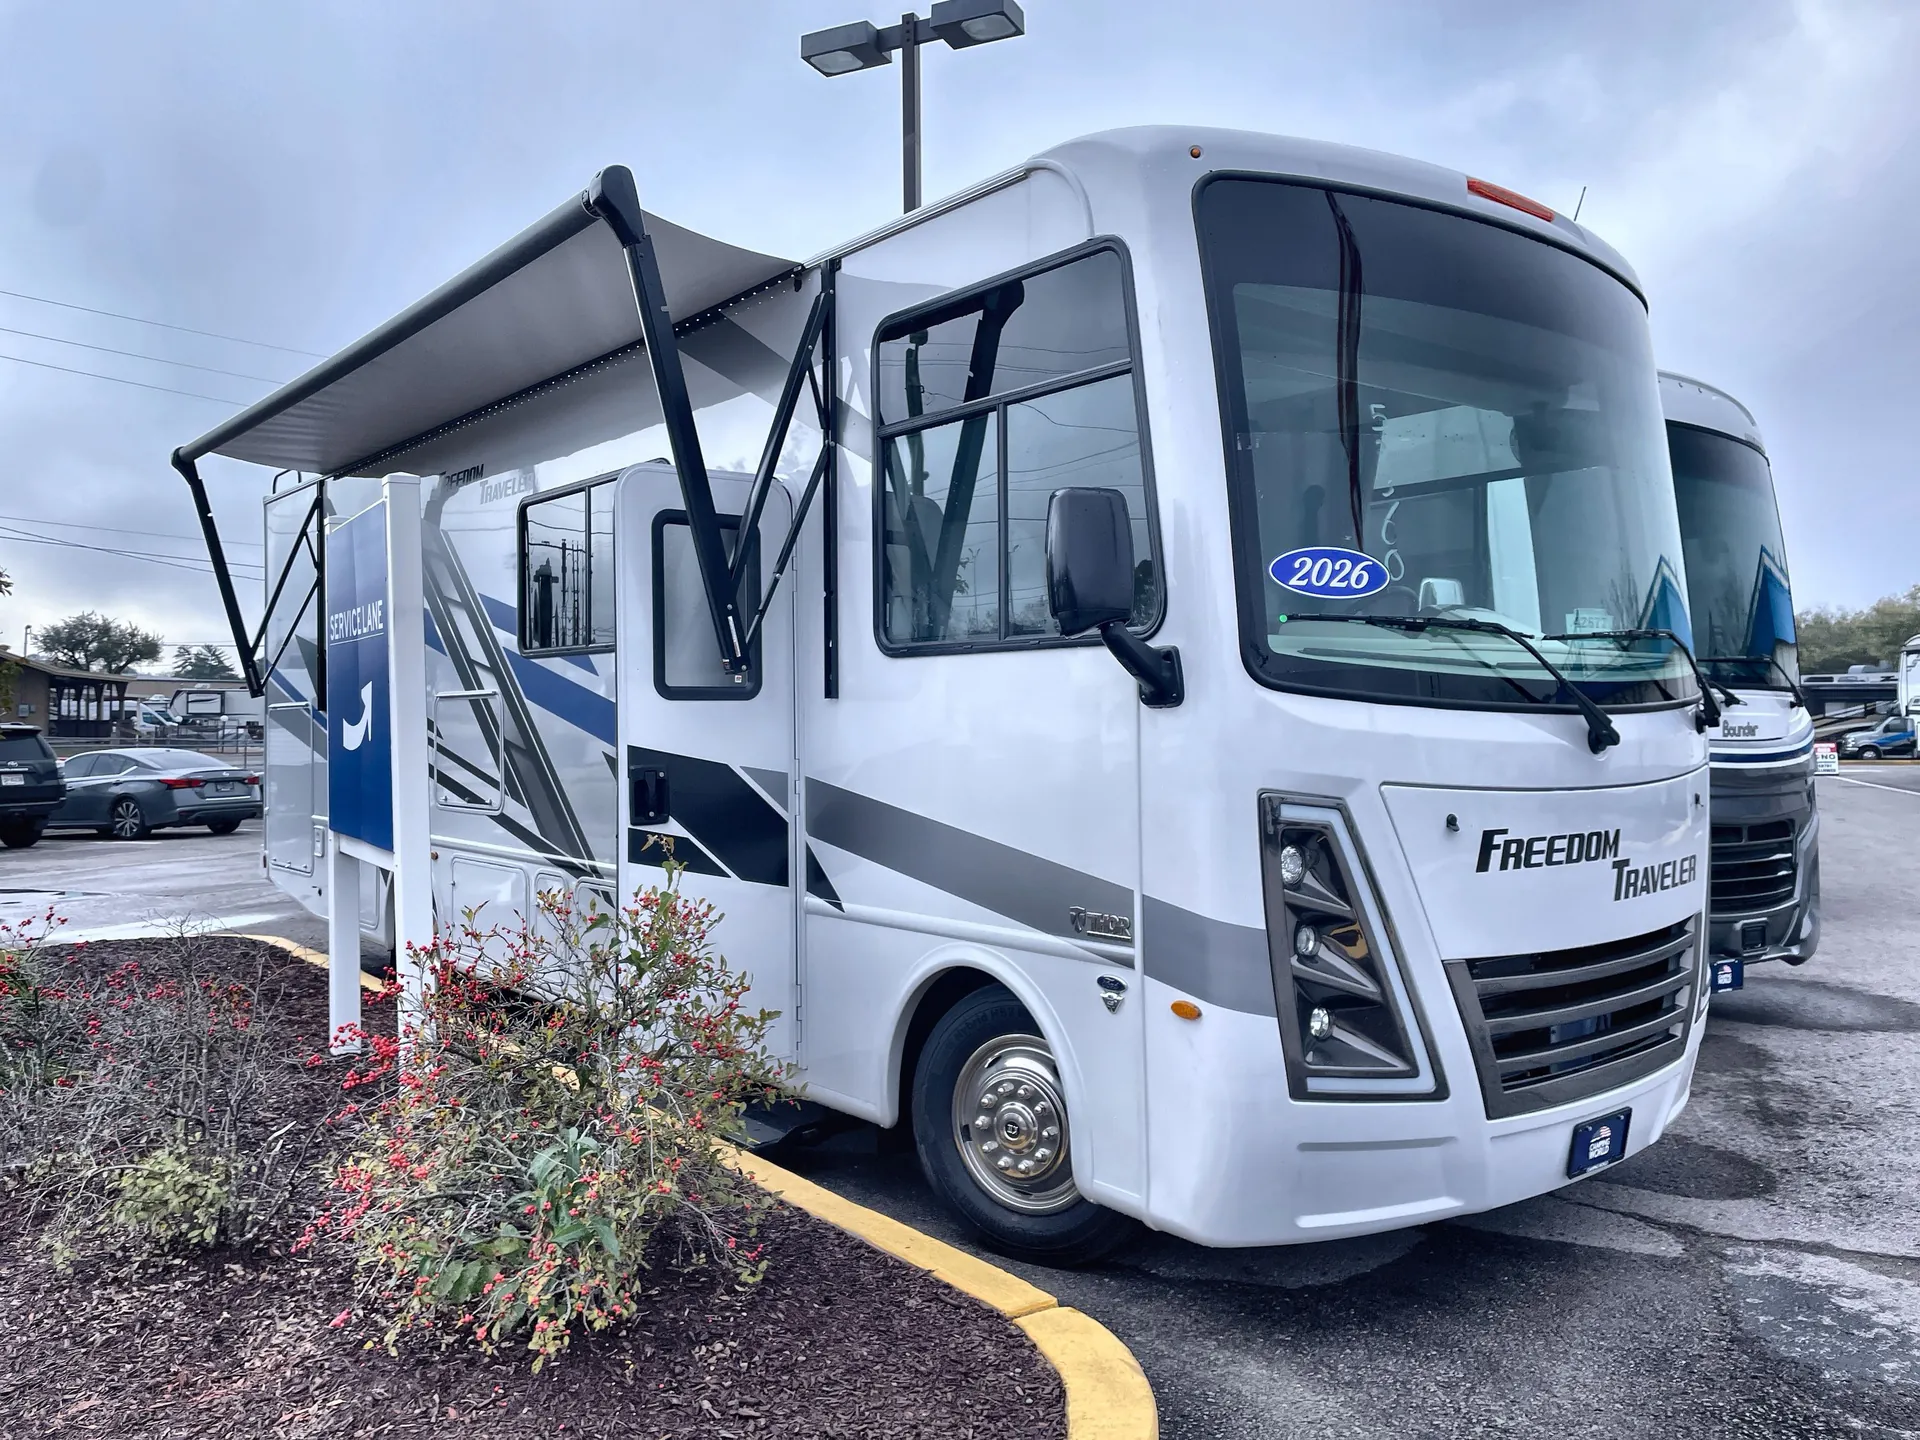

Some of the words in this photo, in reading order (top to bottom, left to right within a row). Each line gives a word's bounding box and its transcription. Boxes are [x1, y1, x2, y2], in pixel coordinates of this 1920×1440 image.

[479, 473, 535, 505] TRAVELER
[1287, 556, 1374, 589] 2026
[329, 606, 362, 641] SERVICE
[361, 599, 384, 634] LANE
[1722, 719, 1759, 738] Bounder
[1474, 827, 1621, 874] FREEDOM
[1611, 854, 1698, 902] TRAVELER
[1085, 911, 1131, 938] THOR
